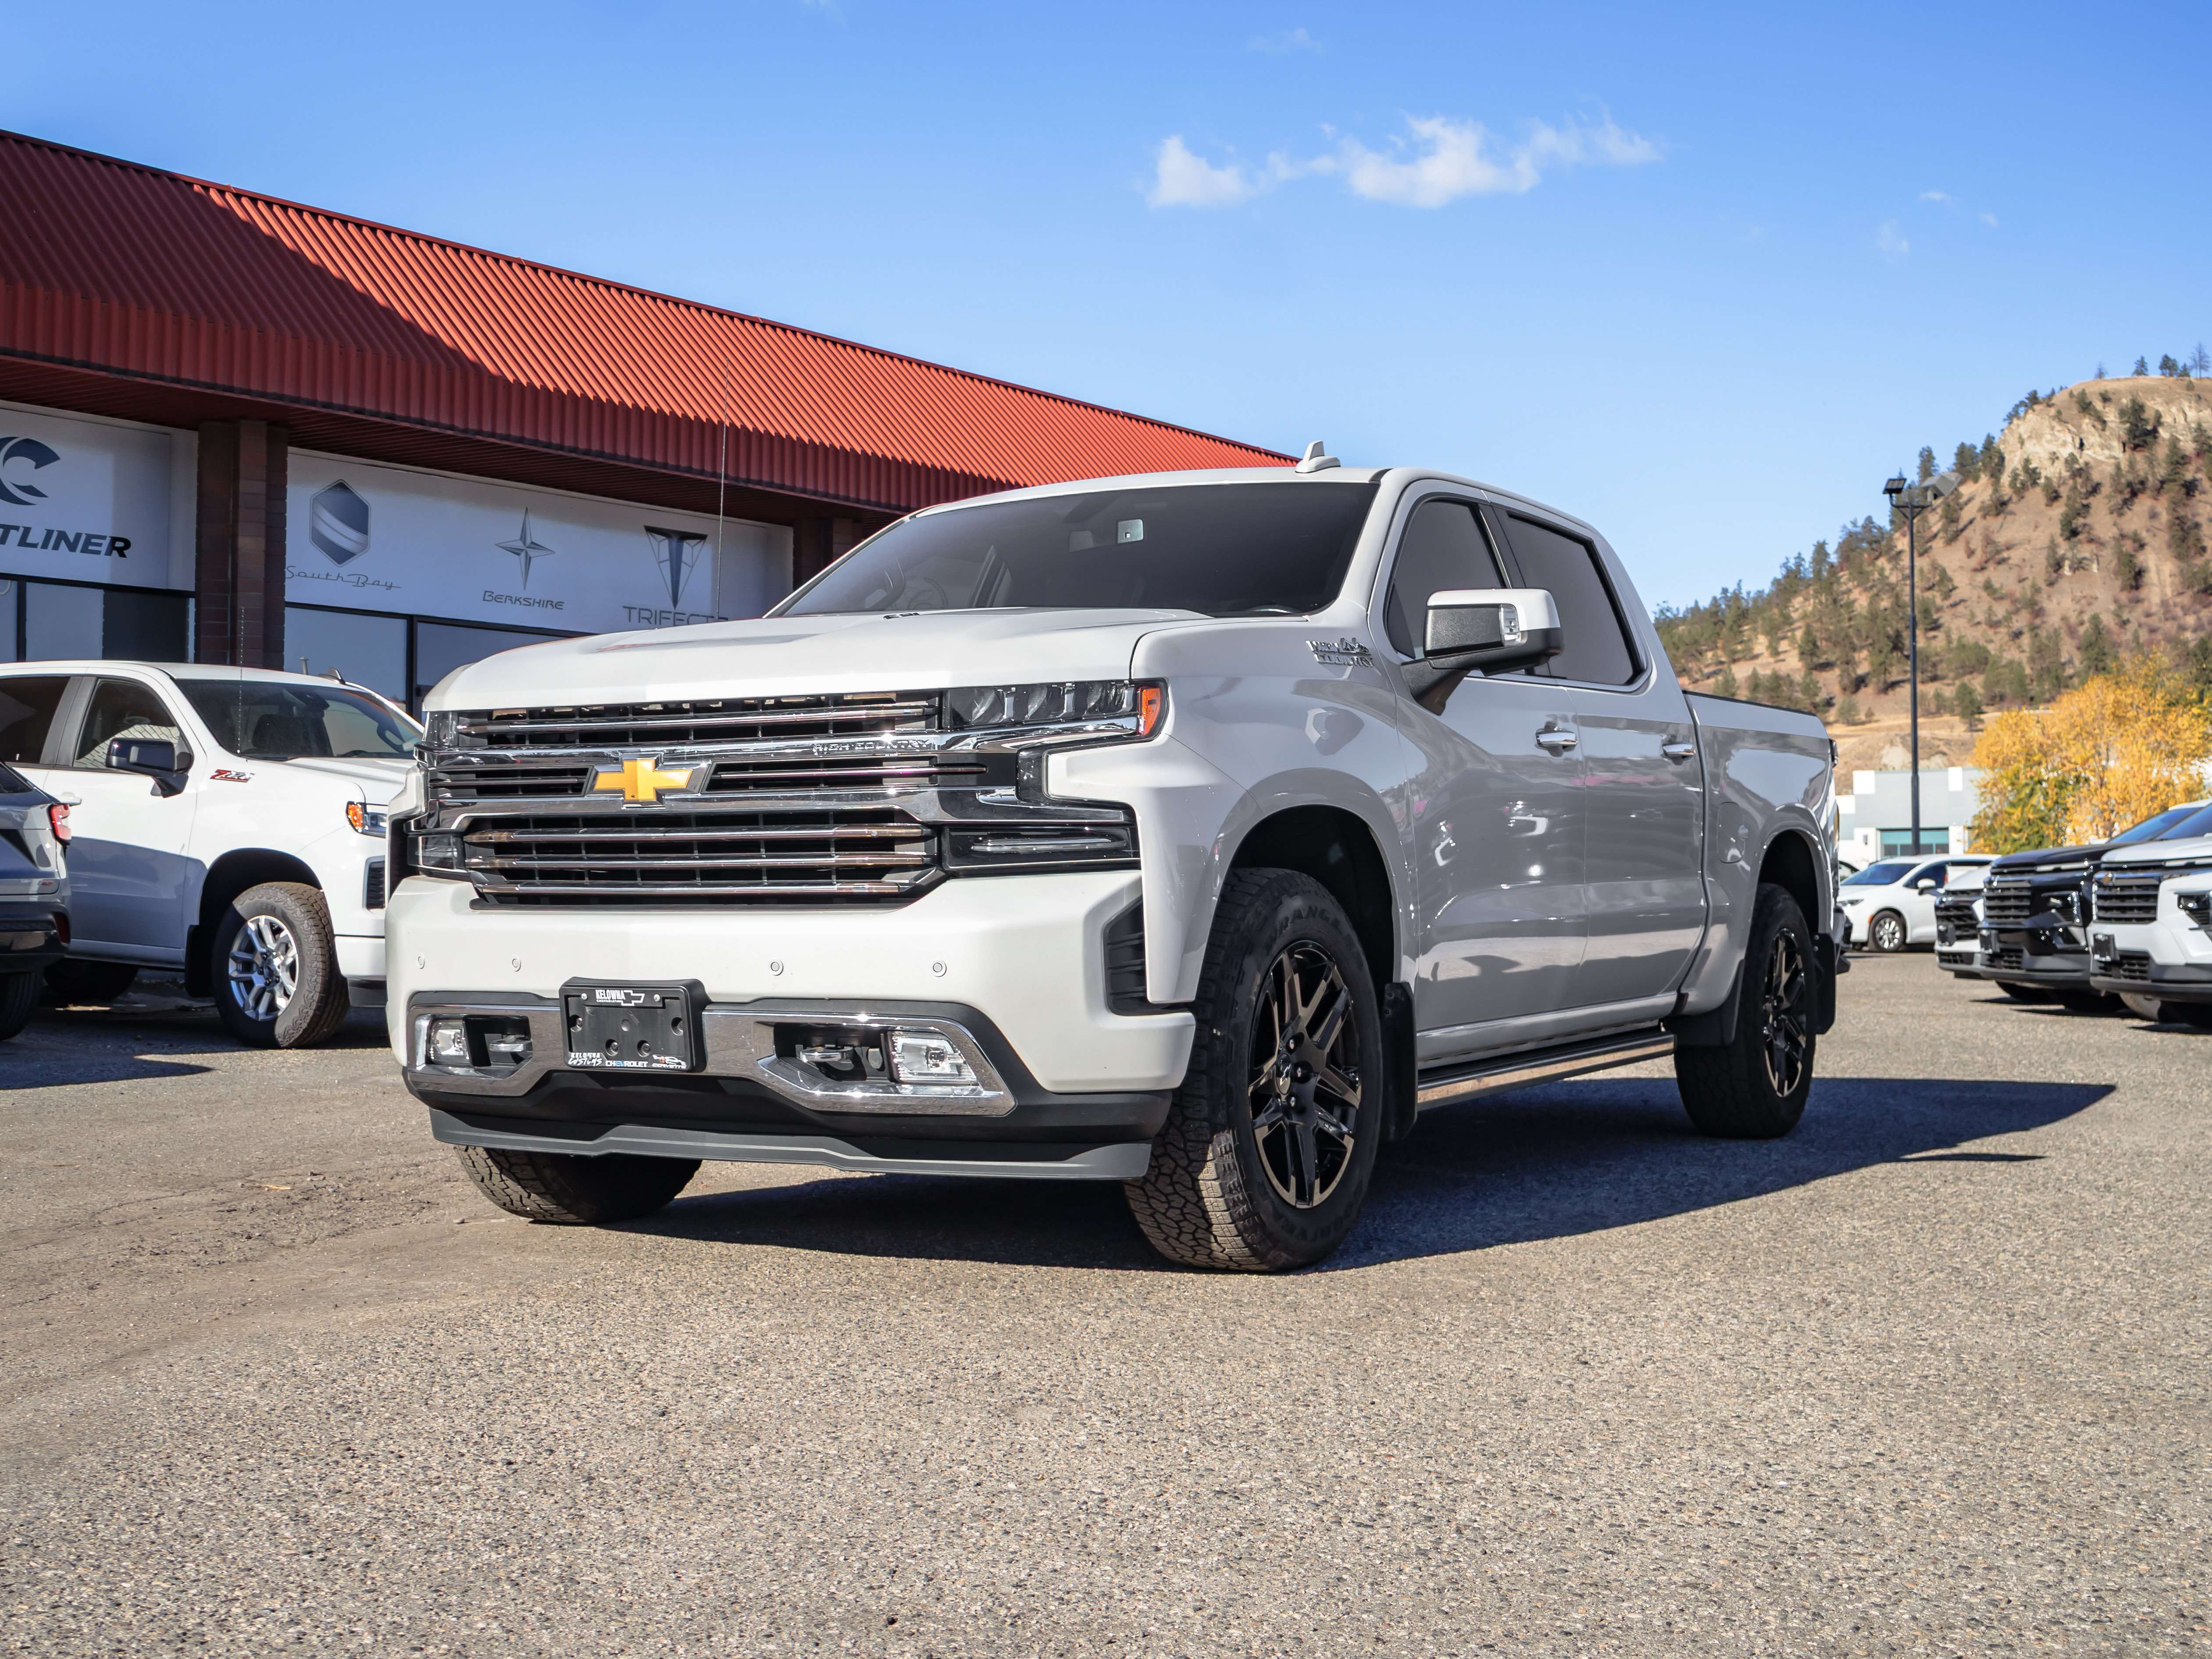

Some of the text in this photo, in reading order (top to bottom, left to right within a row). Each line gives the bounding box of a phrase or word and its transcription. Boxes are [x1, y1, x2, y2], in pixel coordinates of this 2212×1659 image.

[285, 566, 401, 590] South Bay
[622, 605, 729, 626] TRIFECT
[210, 769, 255, 782] Z71
[595, 989, 625, 1000] KELOWNA
